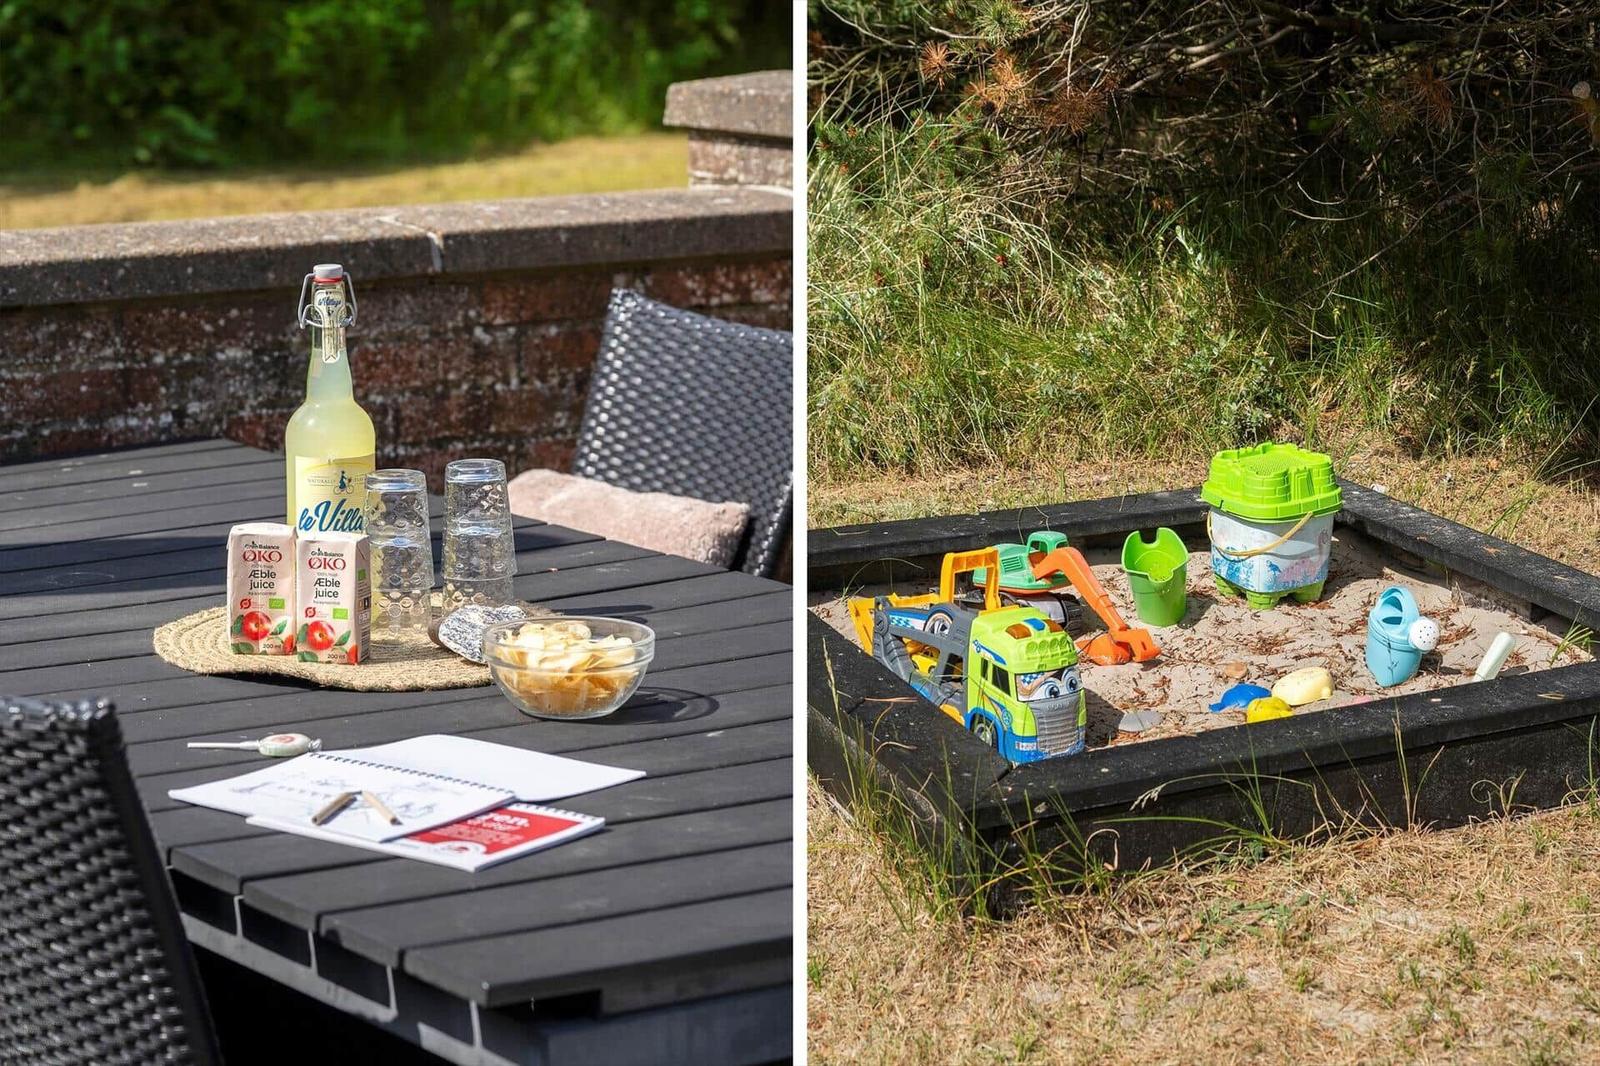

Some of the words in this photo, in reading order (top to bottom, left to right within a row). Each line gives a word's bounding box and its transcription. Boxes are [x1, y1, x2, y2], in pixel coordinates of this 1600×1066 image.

[298, 507, 316, 532] le
[243, 550, 282, 562] ØKO
[309, 557, 346, 570] ØKO
[248, 569, 277, 579] Æble
[250, 580, 275, 590] juice
[313, 577, 341, 588] Æble
[314, 587, 339, 599] juice
